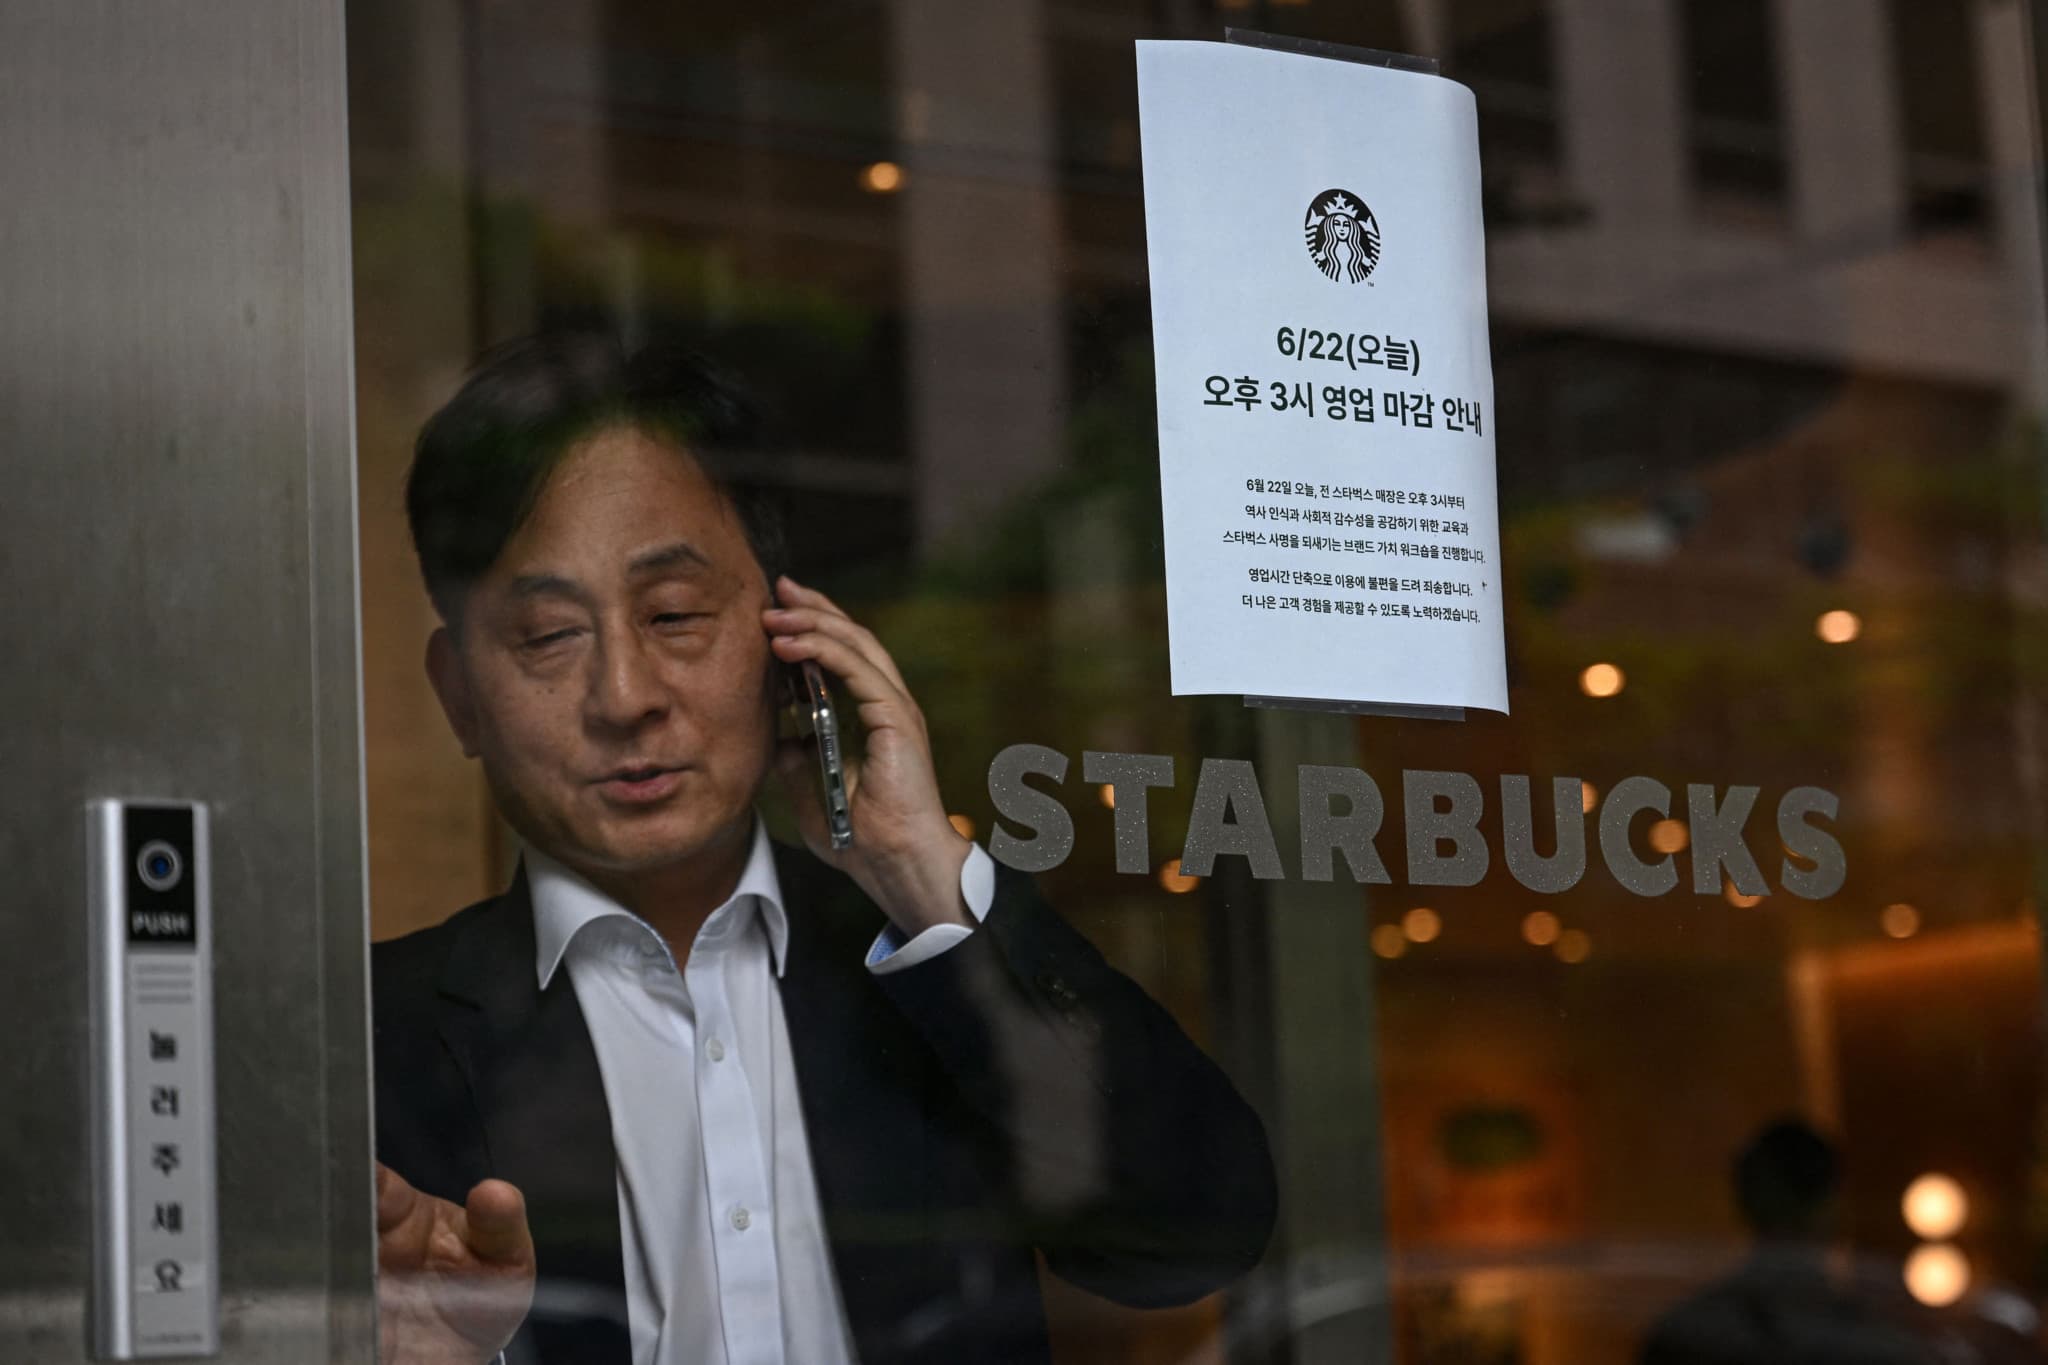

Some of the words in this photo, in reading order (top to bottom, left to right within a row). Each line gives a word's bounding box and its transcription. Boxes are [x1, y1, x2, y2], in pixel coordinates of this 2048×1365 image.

[1277, 326, 1420, 376] 6/22(오늘)
[1203, 374, 1262, 412] 오후
[1270, 381, 1314, 418] 3시
[1322, 385, 1375, 423] 영업
[1383, 391, 1435, 429] 마감
[1442, 397, 1482, 437] 안내
[1246, 478, 1265, 493] 6월
[1267, 480, 1292, 495] 22일
[1294, 482, 1317, 499] 오늘,
[1319, 484, 1330, 499] 전
[1332, 486, 1374, 502] 스타벅스
[1375, 489, 1406, 505] 매장은
[1408, 492, 1428, 506] 오후
[1430, 494, 1465, 510] 3시부터
[1245, 504, 1267, 520] 역사
[1268, 506, 1300, 523] 인식과
[1302, 509, 1332, 525] 사회적
[1334, 512, 1375, 529] 감수성을
[1377, 515, 1418, 532] 공감하기
[1420, 518, 1440, 533] 위한
[1442, 520, 1469, 536] 교육과
[1223, 530, 1267, 546] 스타벅스
[1269, 532, 1300, 549] 사명을
[1302, 536, 1342, 552] 되새기는
[1344, 539, 1376, 554] 브랜드
[1377, 541, 1398, 557] 가치
[1400, 543, 1440, 560] 워크숍을
[1441, 546, 1486, 565] 진행합니다.
[1248, 568, 1291, 585] 영업시간
[1292, 570, 1333, 586] 단축으로
[1335, 574, 1366, 590] 이용에
[1368, 576, 1399, 592] 불편을
[1401, 579, 1421, 593] 드려
[1423, 580, 1473, 597] 죄송합니다.
[1242, 594, 1253, 609] 더
[1255, 595, 1277, 610] 나은
[1279, 597, 1300, 612] 고객
[1302, 598, 1332, 614] 경험을
[1334, 600, 1365, 616] 제공할
[1367, 602, 1378, 617] 수
[1380, 603, 1410, 618] 있도록
[1412, 605, 1481, 624] 노력하겠습니다.
[988, 744, 1846, 899] STARBUCKS
[131, 911, 189, 936] PUSH
